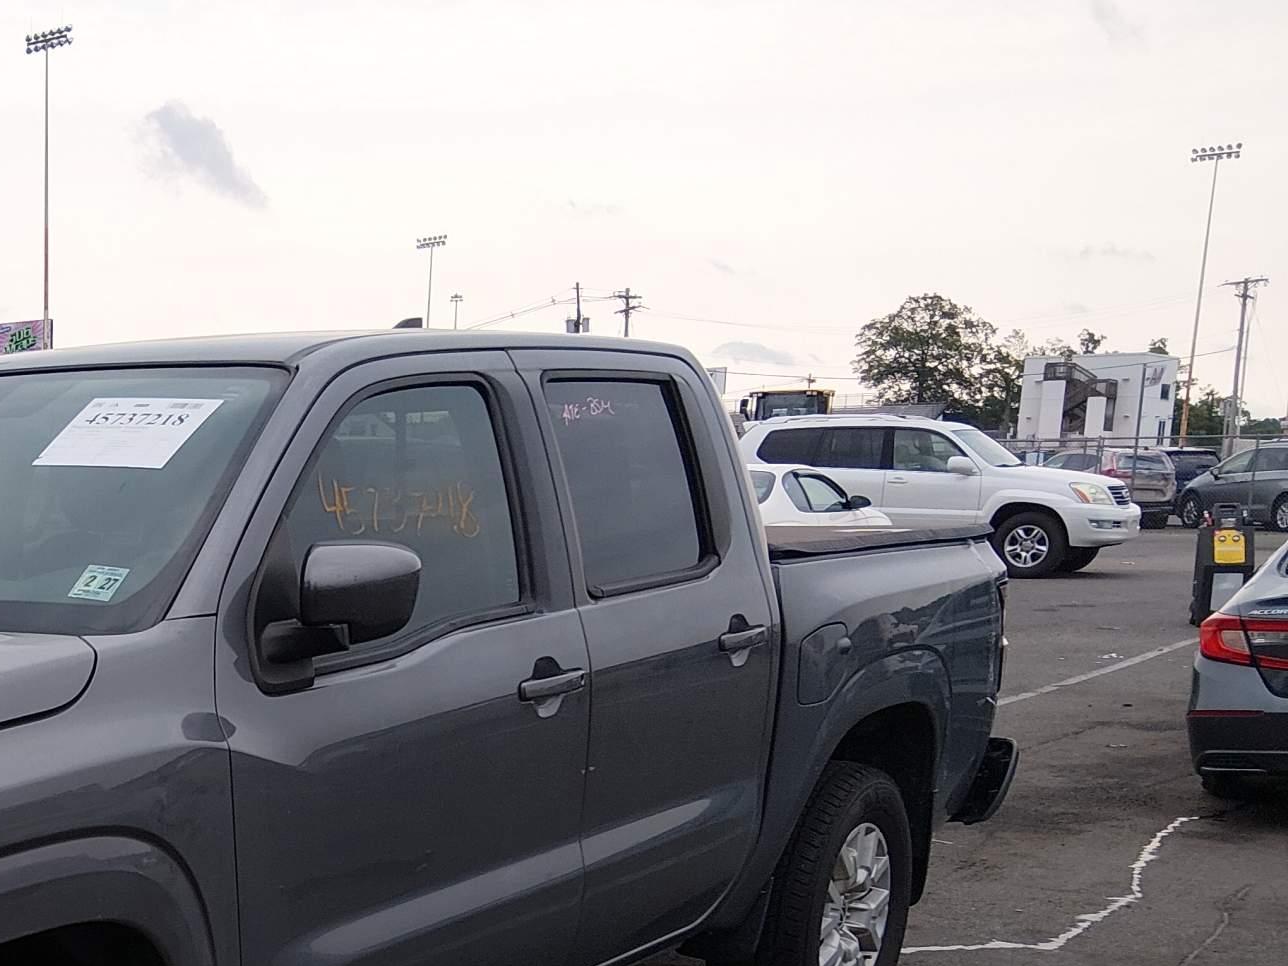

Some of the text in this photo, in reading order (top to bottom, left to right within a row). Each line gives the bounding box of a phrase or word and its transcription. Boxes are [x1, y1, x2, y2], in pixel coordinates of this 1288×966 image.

[84, 413, 190, 426] 45737218
[83, 575, 120, 591] 2 27
